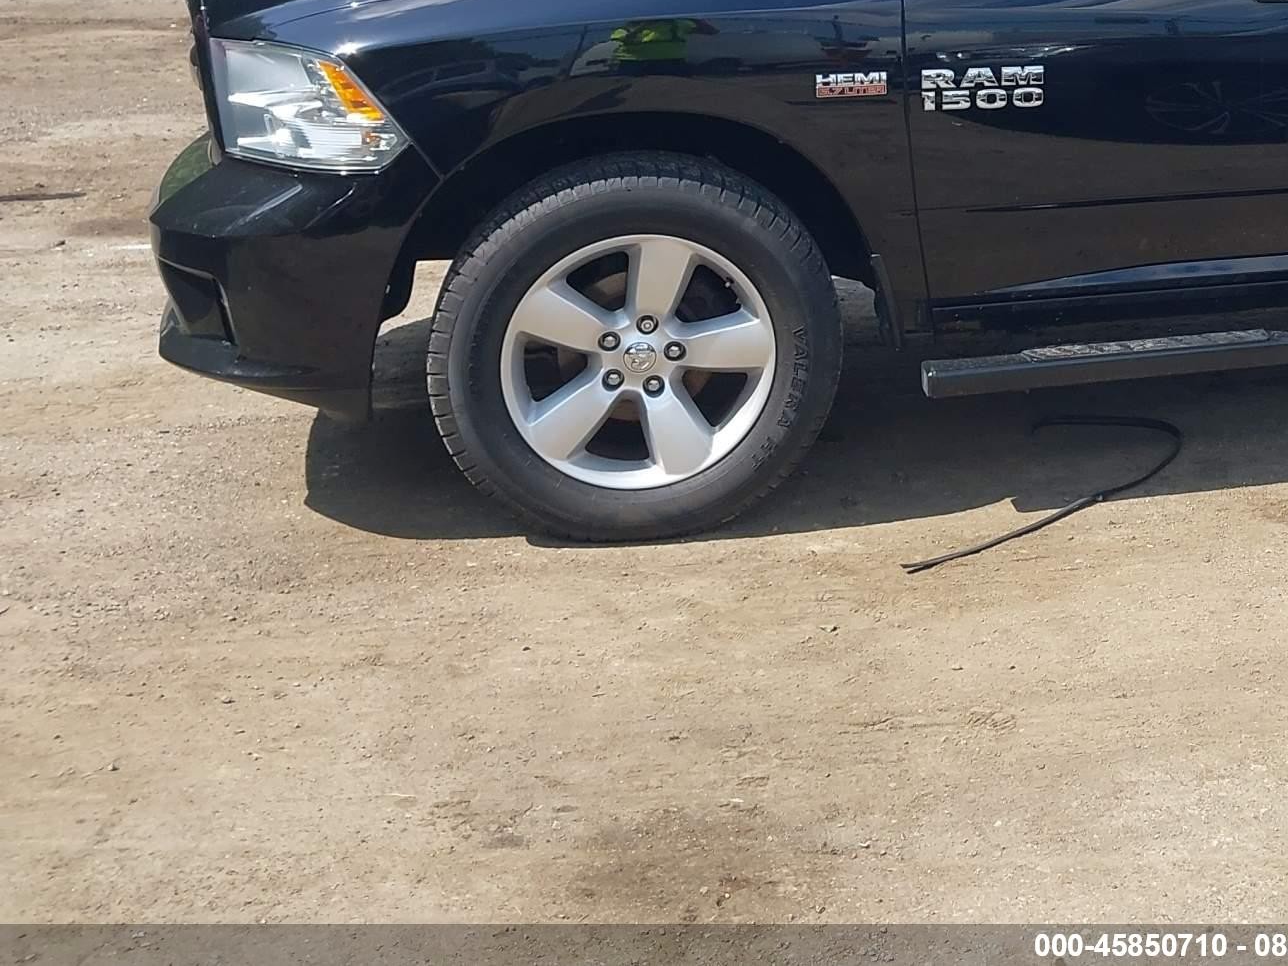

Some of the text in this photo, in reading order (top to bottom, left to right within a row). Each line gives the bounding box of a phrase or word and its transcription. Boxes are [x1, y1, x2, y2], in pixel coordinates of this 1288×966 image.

[816, 72, 887, 87] HEMI
[921, 66, 1044, 89] RAM
[921, 87, 1044, 111] 1500
